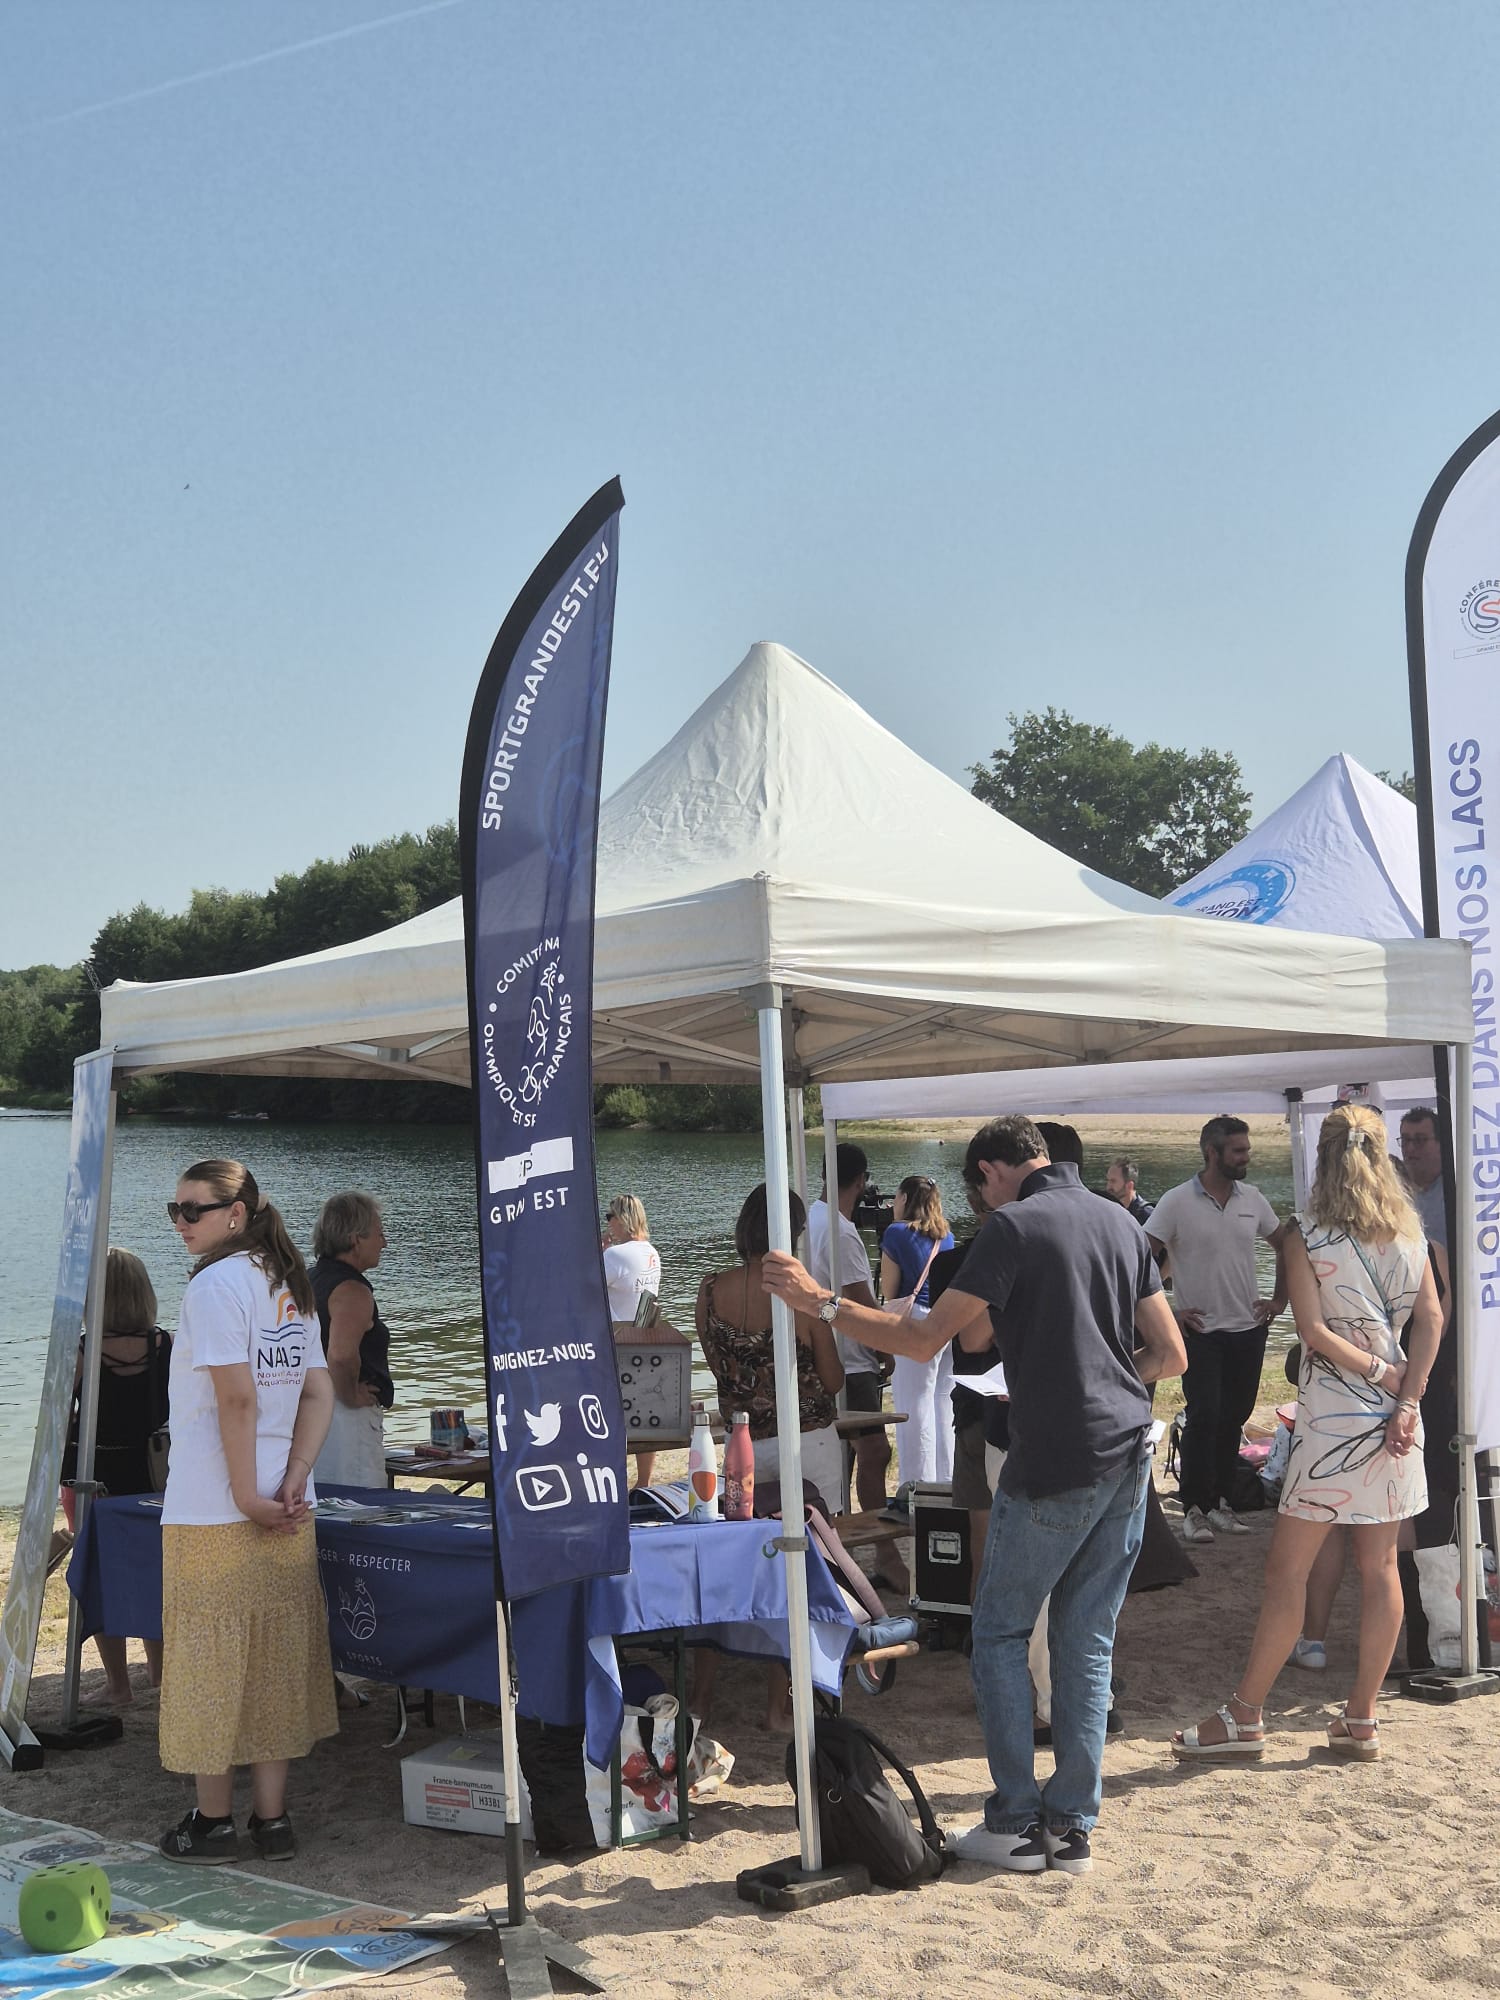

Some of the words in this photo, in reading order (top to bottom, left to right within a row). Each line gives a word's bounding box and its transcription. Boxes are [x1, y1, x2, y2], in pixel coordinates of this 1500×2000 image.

[1449, 738, 1485, 853] LACS
[1455, 864, 1491, 957] NOS
[1472, 968, 1500, 1089] DANS
[533, 1187, 569, 1211] EST
[1472, 1102, 1500, 1310] PLONGEZ
[348, 1552, 412, 1573] RESPECTER
